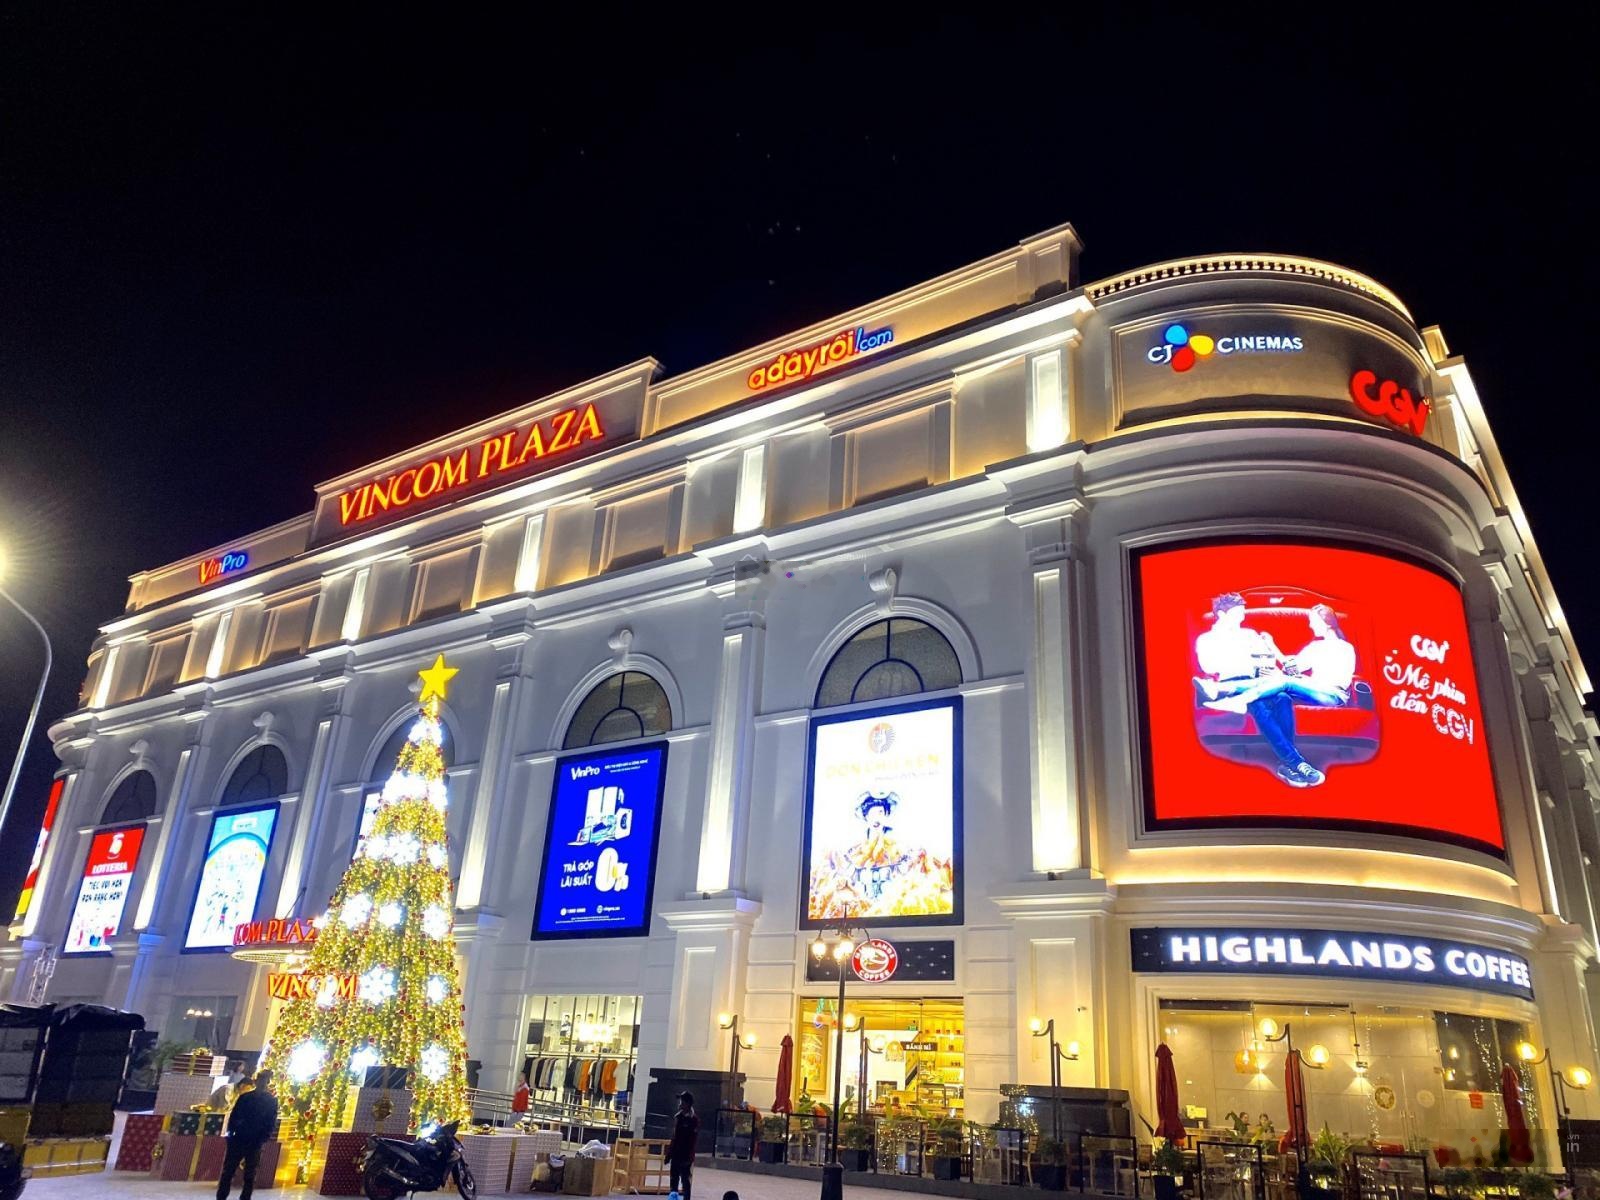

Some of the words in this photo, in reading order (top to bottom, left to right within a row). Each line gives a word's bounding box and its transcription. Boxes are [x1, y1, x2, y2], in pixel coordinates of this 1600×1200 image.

[1147, 344, 1174, 364] CJ
[1216, 335, 1304, 354] CINEMAS
[1352, 370, 1431, 436] CGV
[338, 448, 470, 526] VINCOM
[477, 403, 604, 479] PLAZA
[200, 554, 246, 584] VinPro
[570, 765, 601, 781] VinPro
[1170, 935, 1435, 972] HIGHLANDS
[1444, 949, 1532, 989] COFFEE
